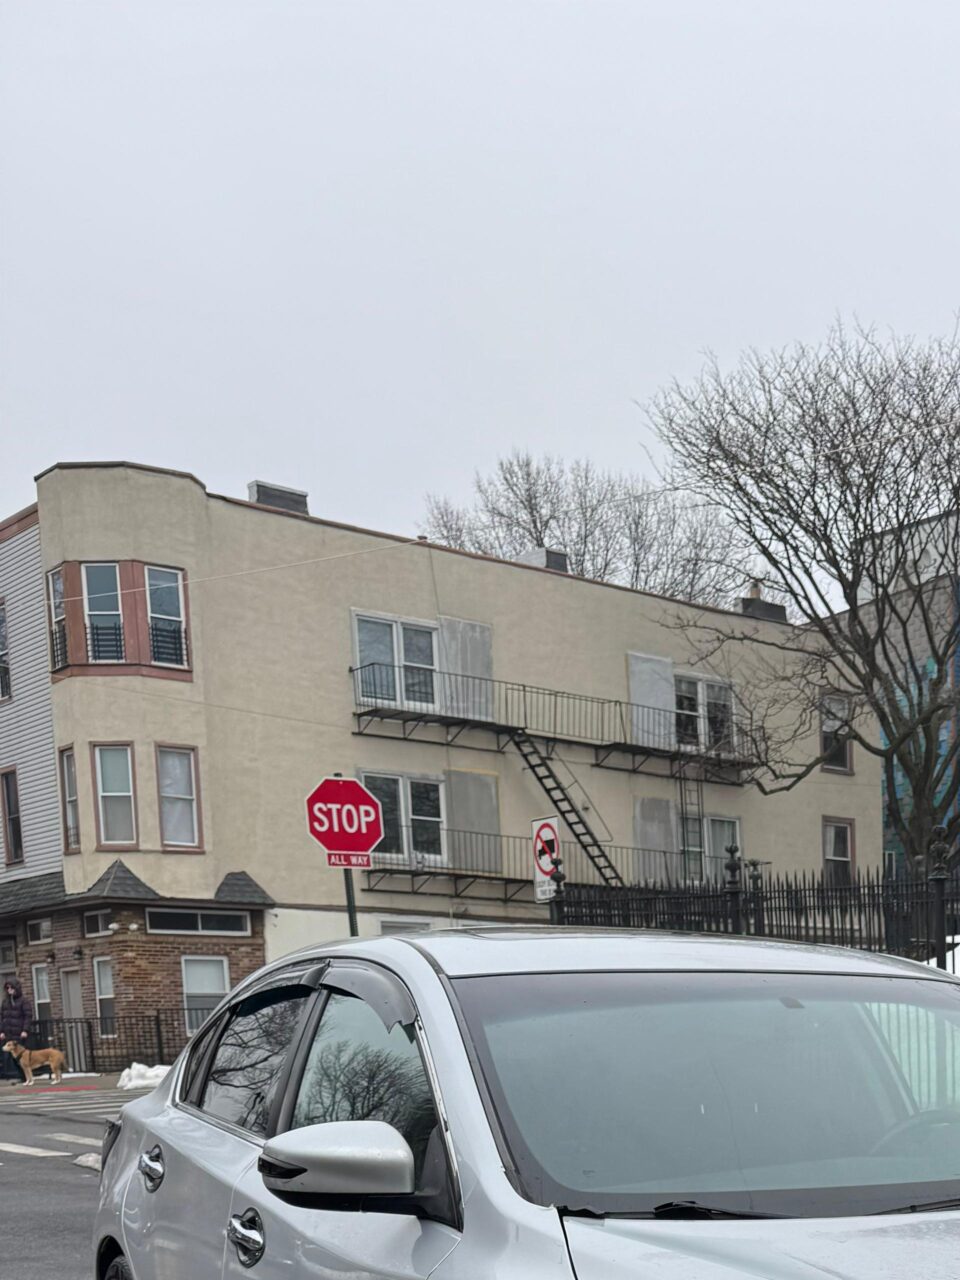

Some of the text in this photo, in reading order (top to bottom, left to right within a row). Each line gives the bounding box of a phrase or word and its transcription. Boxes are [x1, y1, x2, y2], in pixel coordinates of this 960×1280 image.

[312, 802, 376, 834] STOP
[330, 855, 369, 865] ALL WAY
